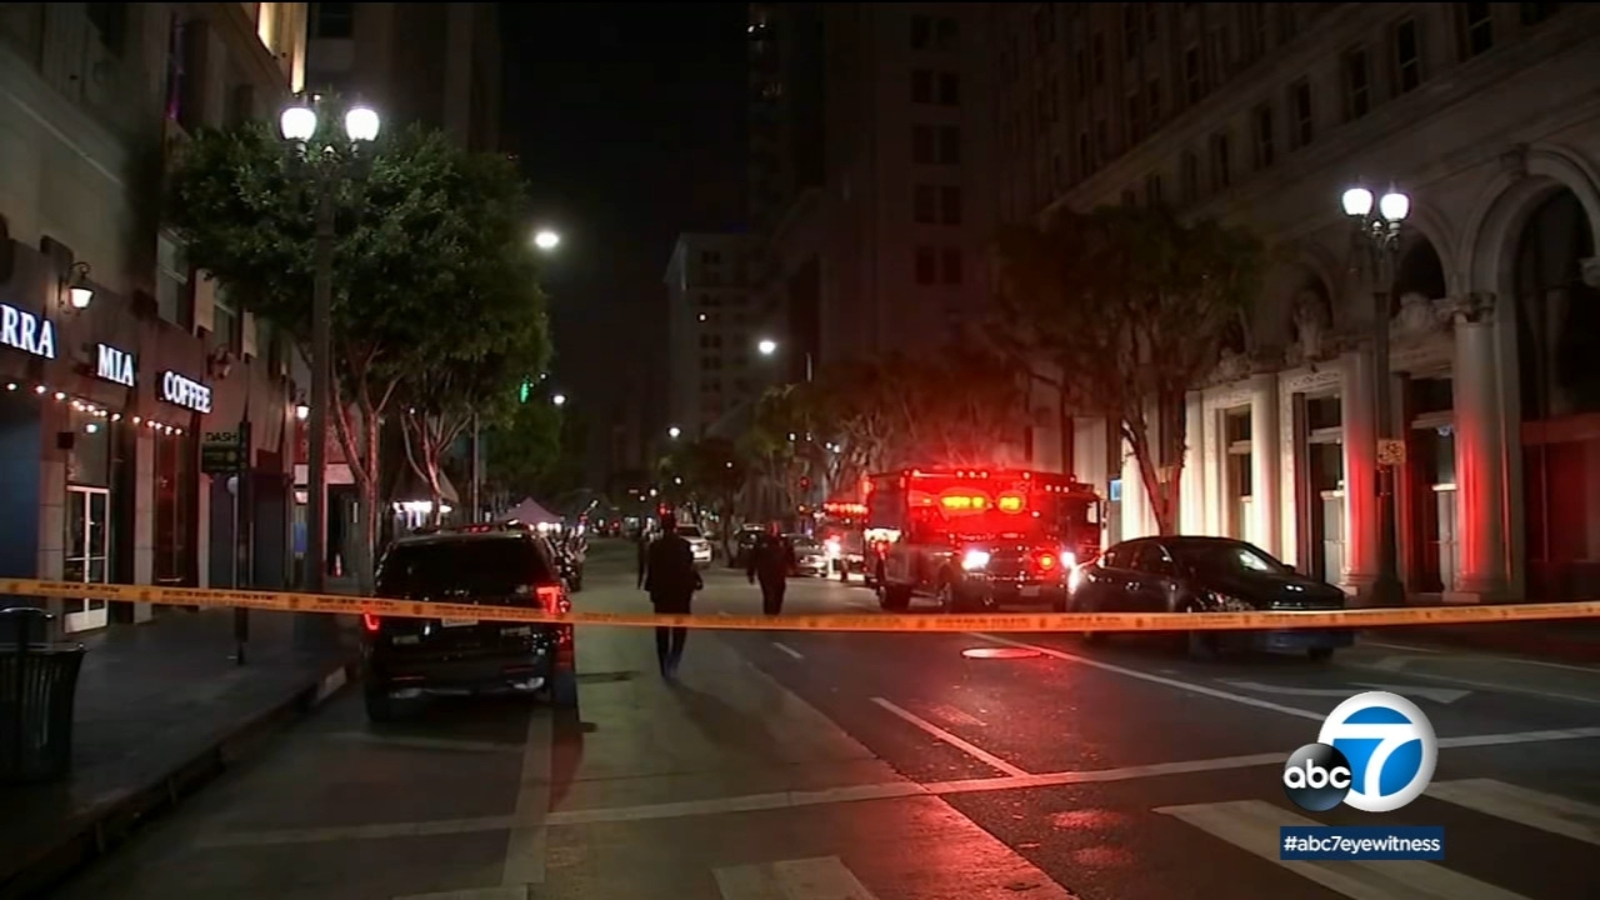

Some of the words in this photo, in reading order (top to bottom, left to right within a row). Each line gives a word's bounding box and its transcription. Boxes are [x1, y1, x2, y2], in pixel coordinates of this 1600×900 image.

[97, 343, 135, 387] MIA
[162, 370, 211, 413] COFFEE
[205, 431, 238, 441] DASH
